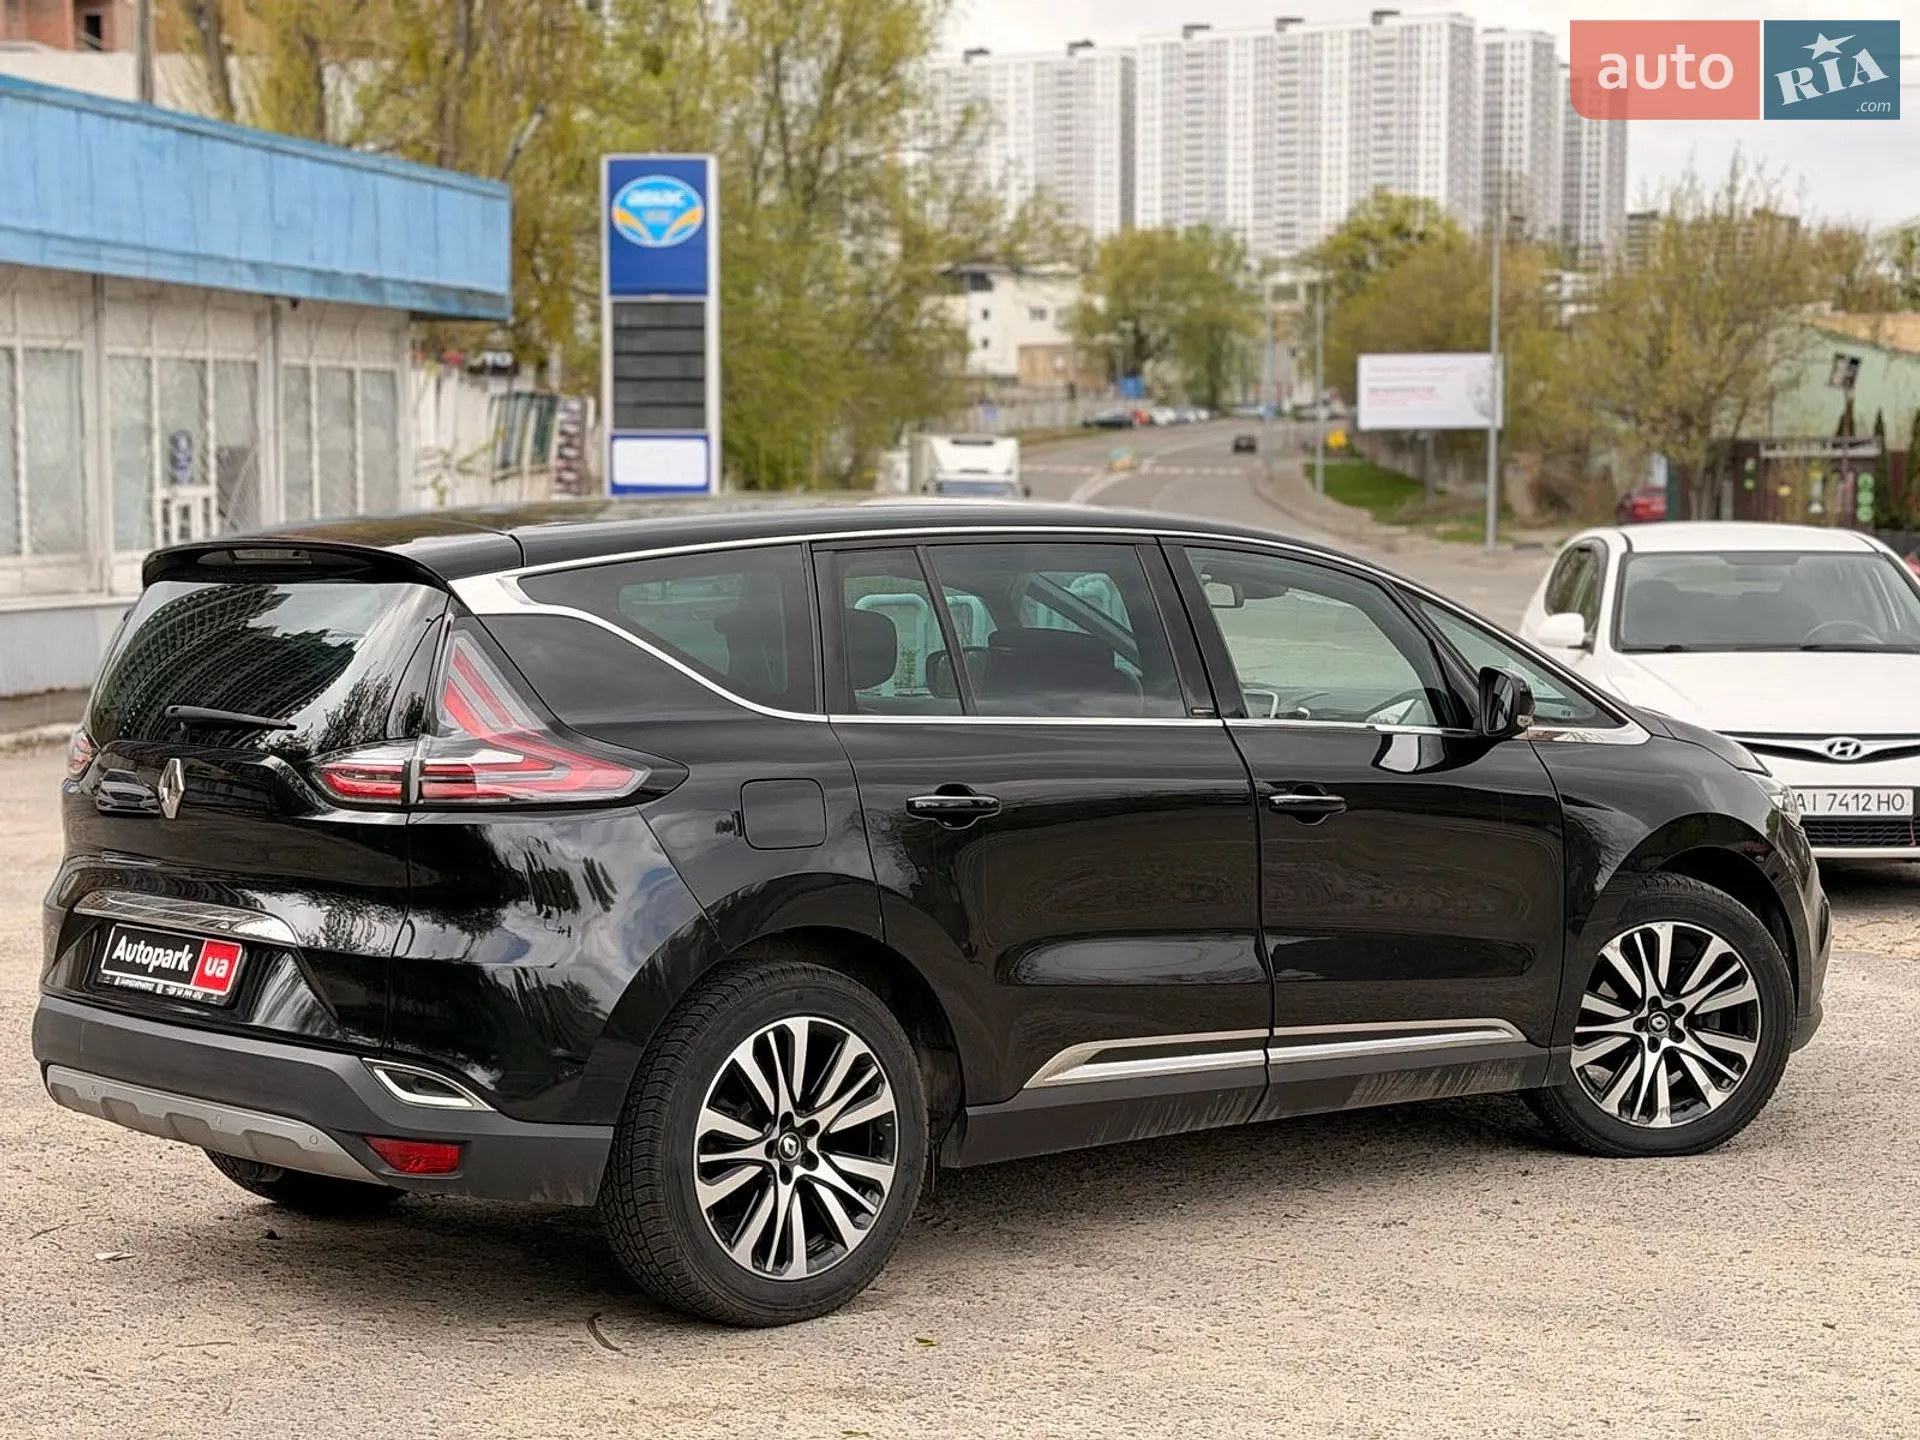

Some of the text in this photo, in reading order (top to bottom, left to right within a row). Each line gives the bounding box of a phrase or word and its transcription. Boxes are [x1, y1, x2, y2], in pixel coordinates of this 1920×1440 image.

[1796, 792, 1905, 812] AI 7412 HO
[111, 935, 230, 979] Autopark ua
